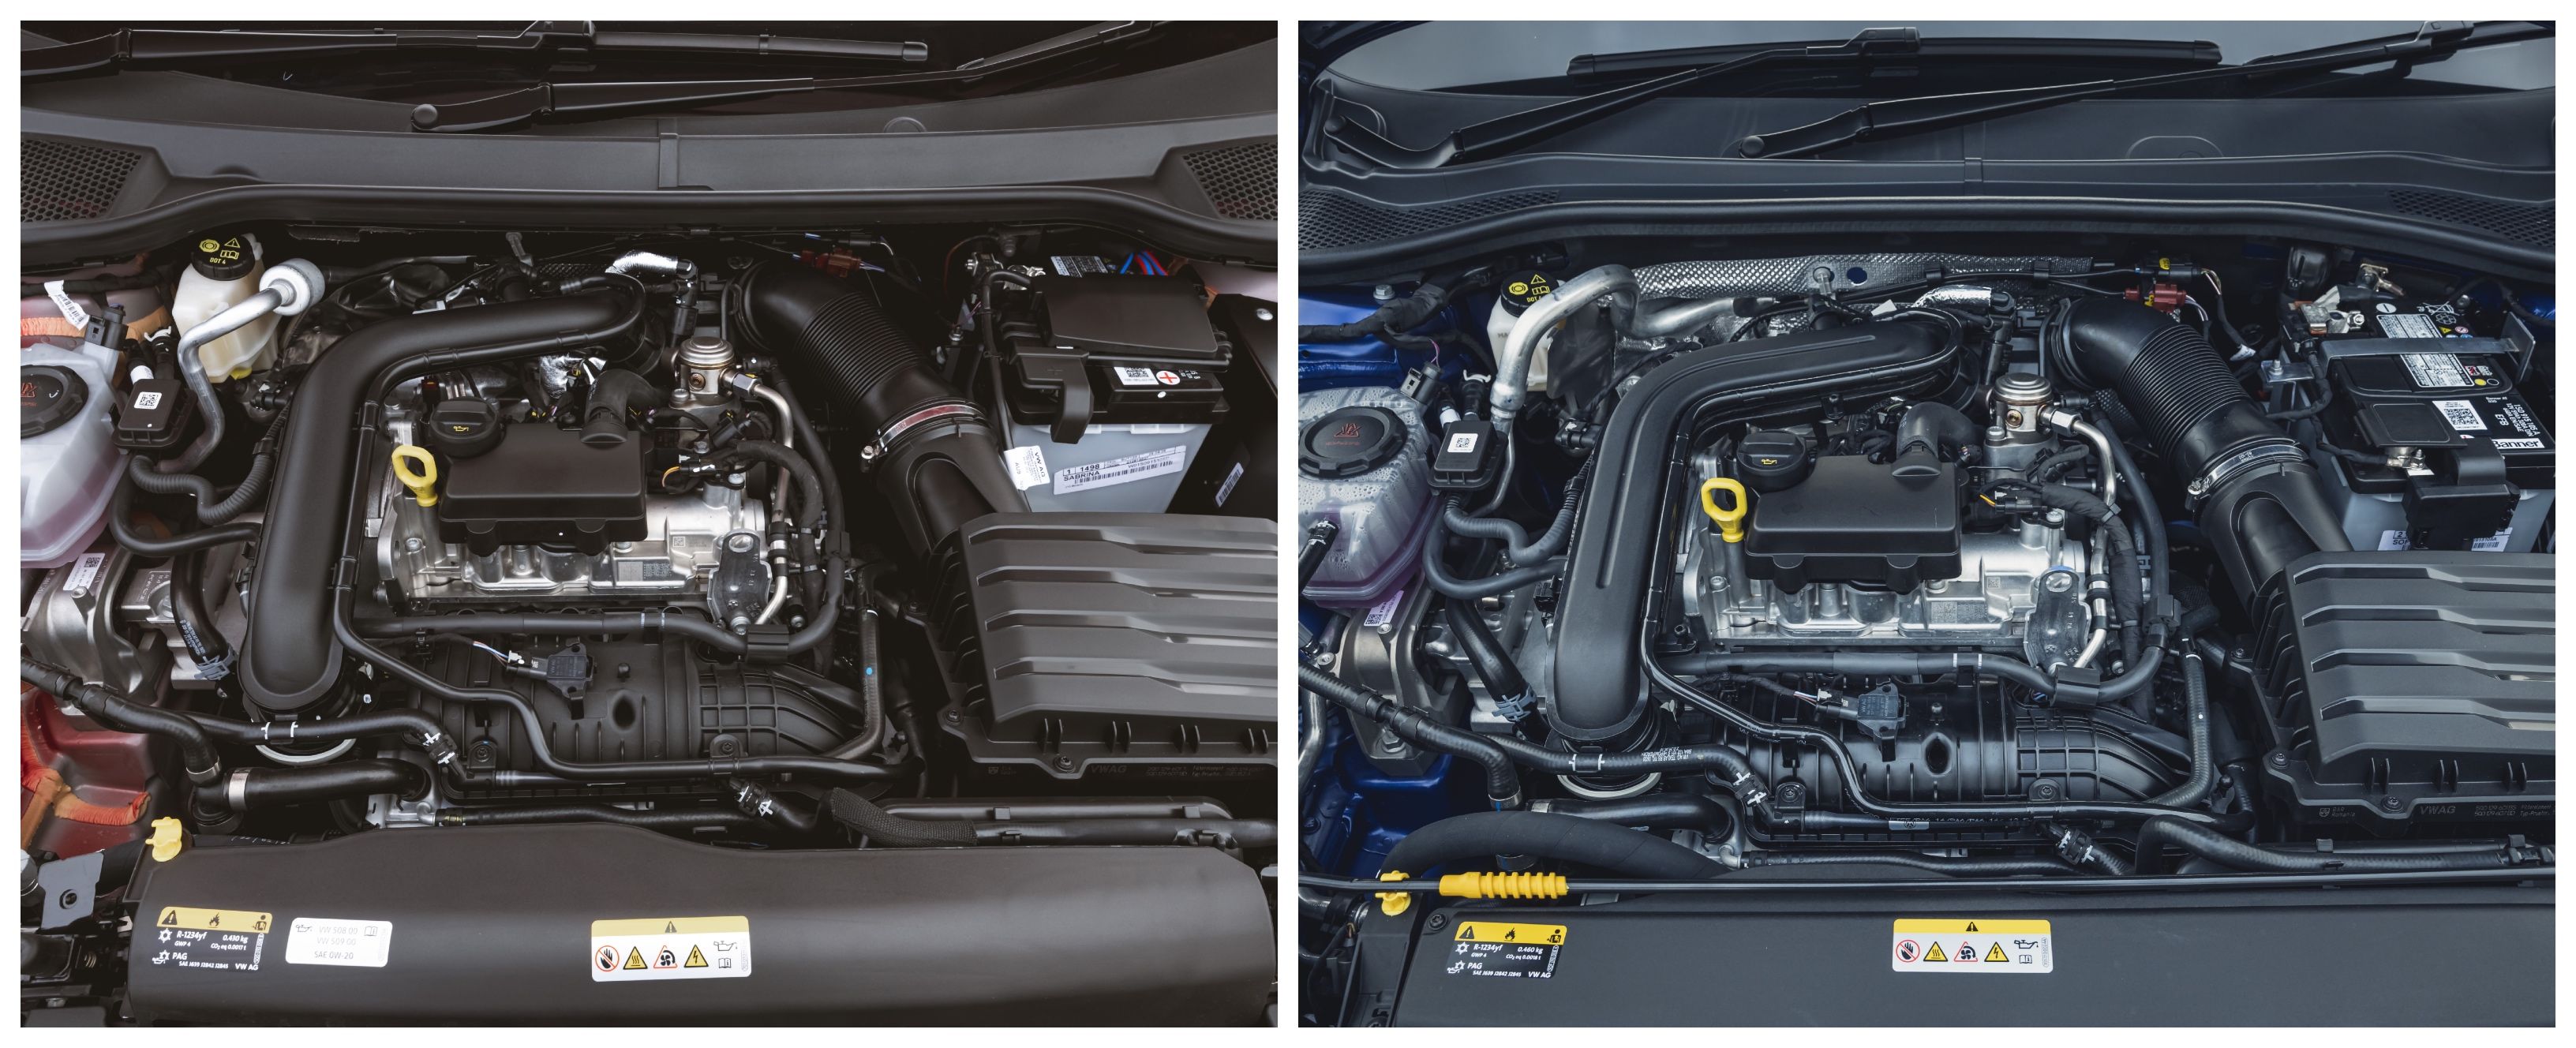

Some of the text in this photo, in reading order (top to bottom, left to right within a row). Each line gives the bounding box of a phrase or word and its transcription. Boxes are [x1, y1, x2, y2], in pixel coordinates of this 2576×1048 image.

[2495, 414, 2509, 425] EFB
[1035, 451, 1046, 477] VW AG
[1080, 463, 1100, 472] 1498
[1063, 470, 1100, 482] SABRINA
[176, 930, 208, 941] R-1234yf
[240, 935, 249, 944] kg
[1473, 944, 1503, 953] R-1234yf
[171, 952, 188, 960] PAG
